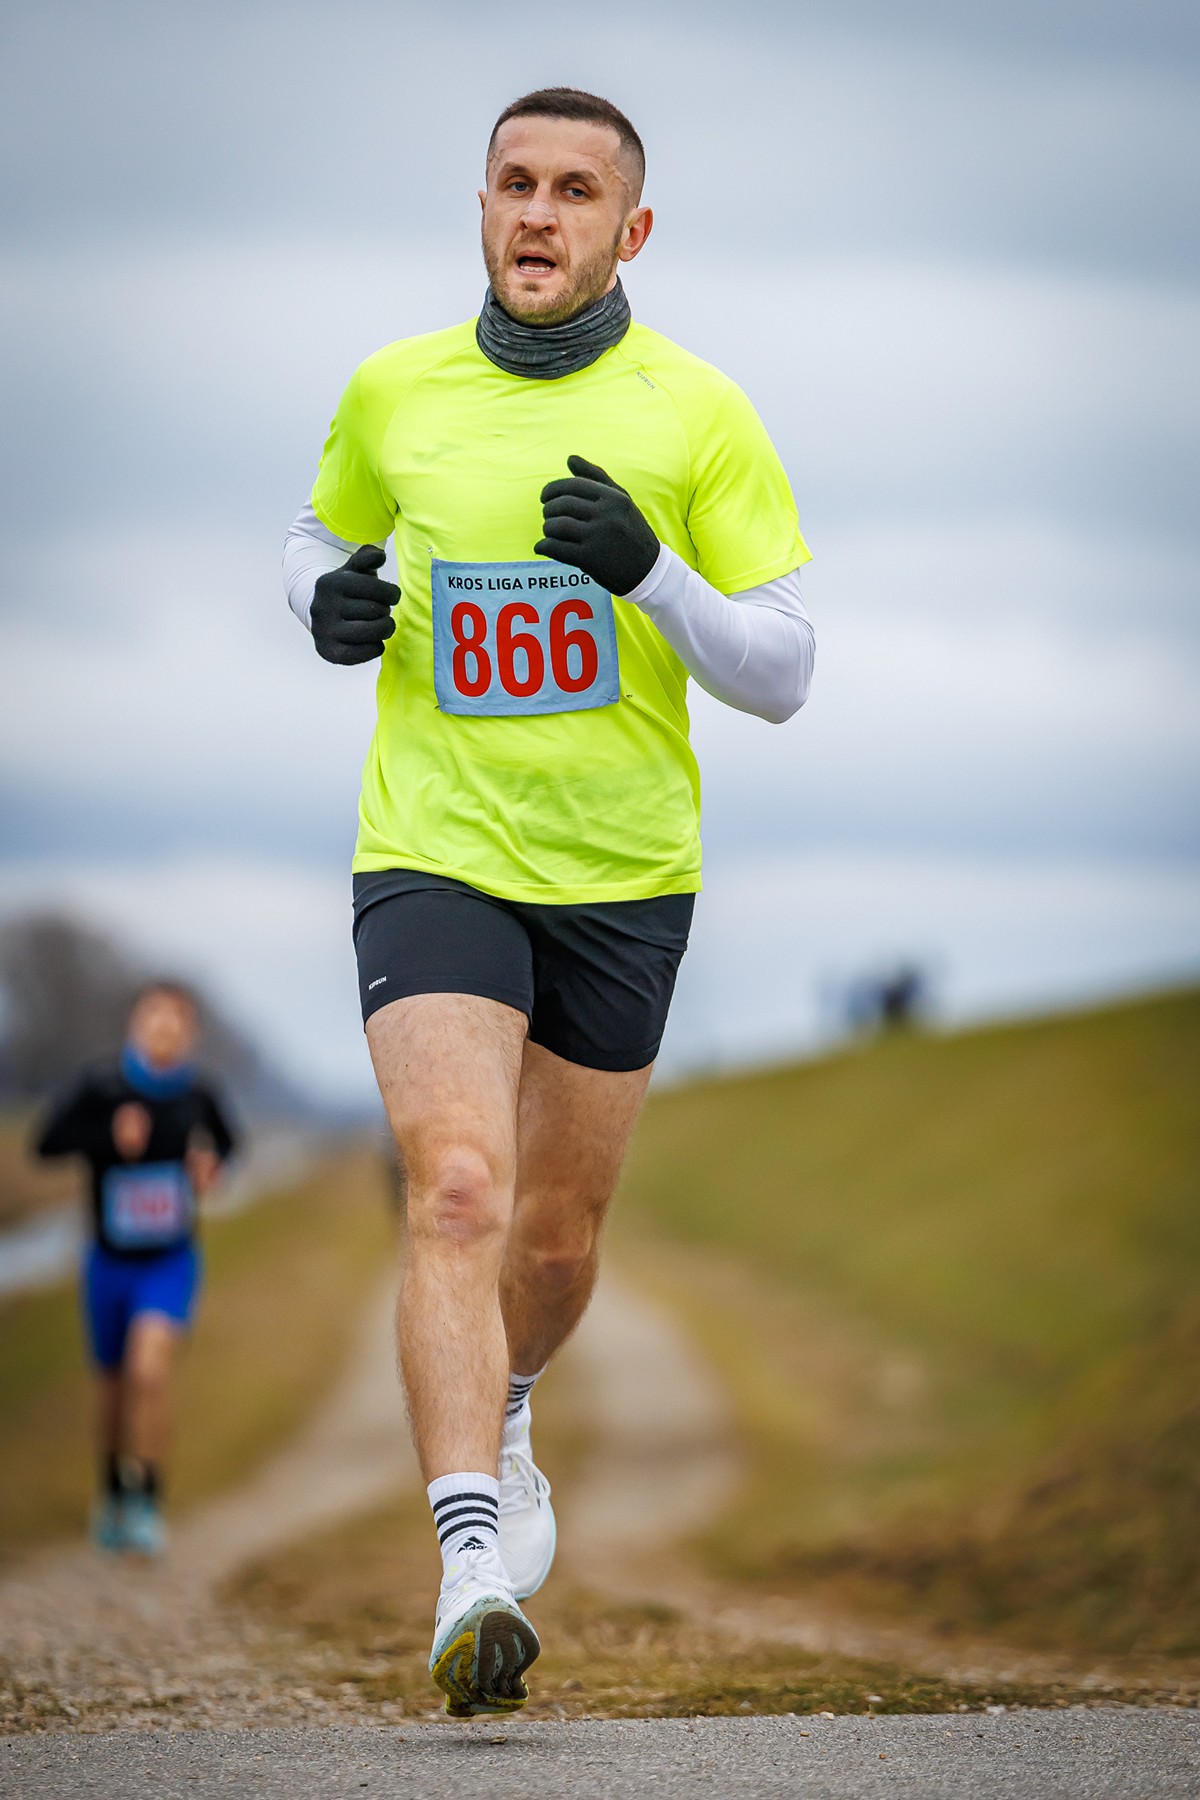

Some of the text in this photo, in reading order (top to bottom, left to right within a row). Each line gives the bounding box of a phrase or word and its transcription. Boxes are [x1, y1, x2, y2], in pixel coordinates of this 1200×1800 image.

[448, 573, 590, 590] KROS LIGA PRELOG
[451, 598, 599, 698] 866
